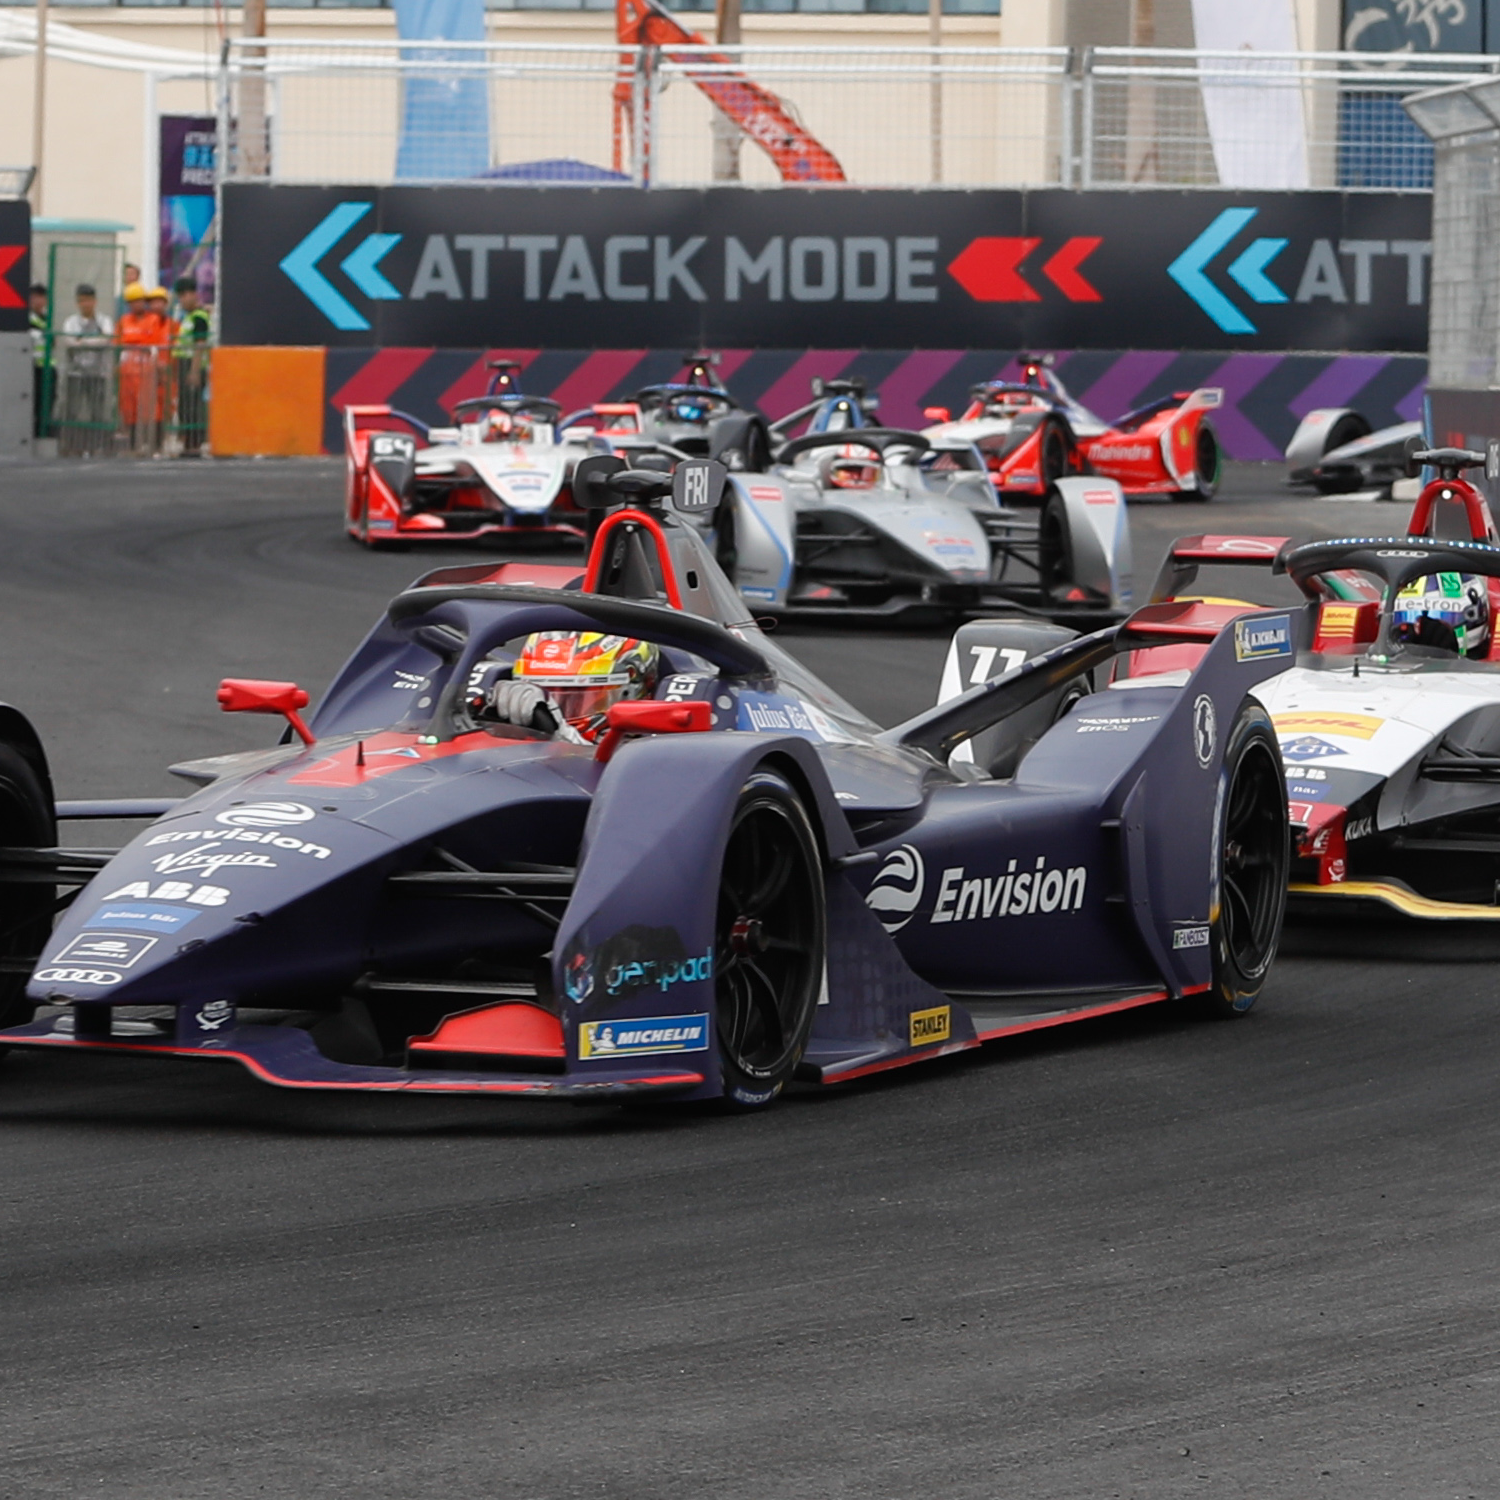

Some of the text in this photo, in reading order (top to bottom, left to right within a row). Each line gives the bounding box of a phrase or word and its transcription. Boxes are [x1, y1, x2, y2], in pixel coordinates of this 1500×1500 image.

[410, 235, 937, 302] ATTACK MODE
[373, 436, 415, 461] 64
[1088, 442, 1154, 461] Mahindra
[684, 466, 710, 506] FRI
[1406, 598, 1462, 612] e-tron
[529, 660, 567, 670] Envision
[744, 703, 790, 732] Julius
[1345, 815, 1373, 843] KUKA
[143, 827, 332, 860] Envision
[151, 842, 278, 878] Virgin
[101, 880, 231, 906] ABB
[930, 855, 1088, 924] Envision
[616, 1025, 702, 1046] MICHELIN
[912, 1013, 949, 1039] STANLEY
